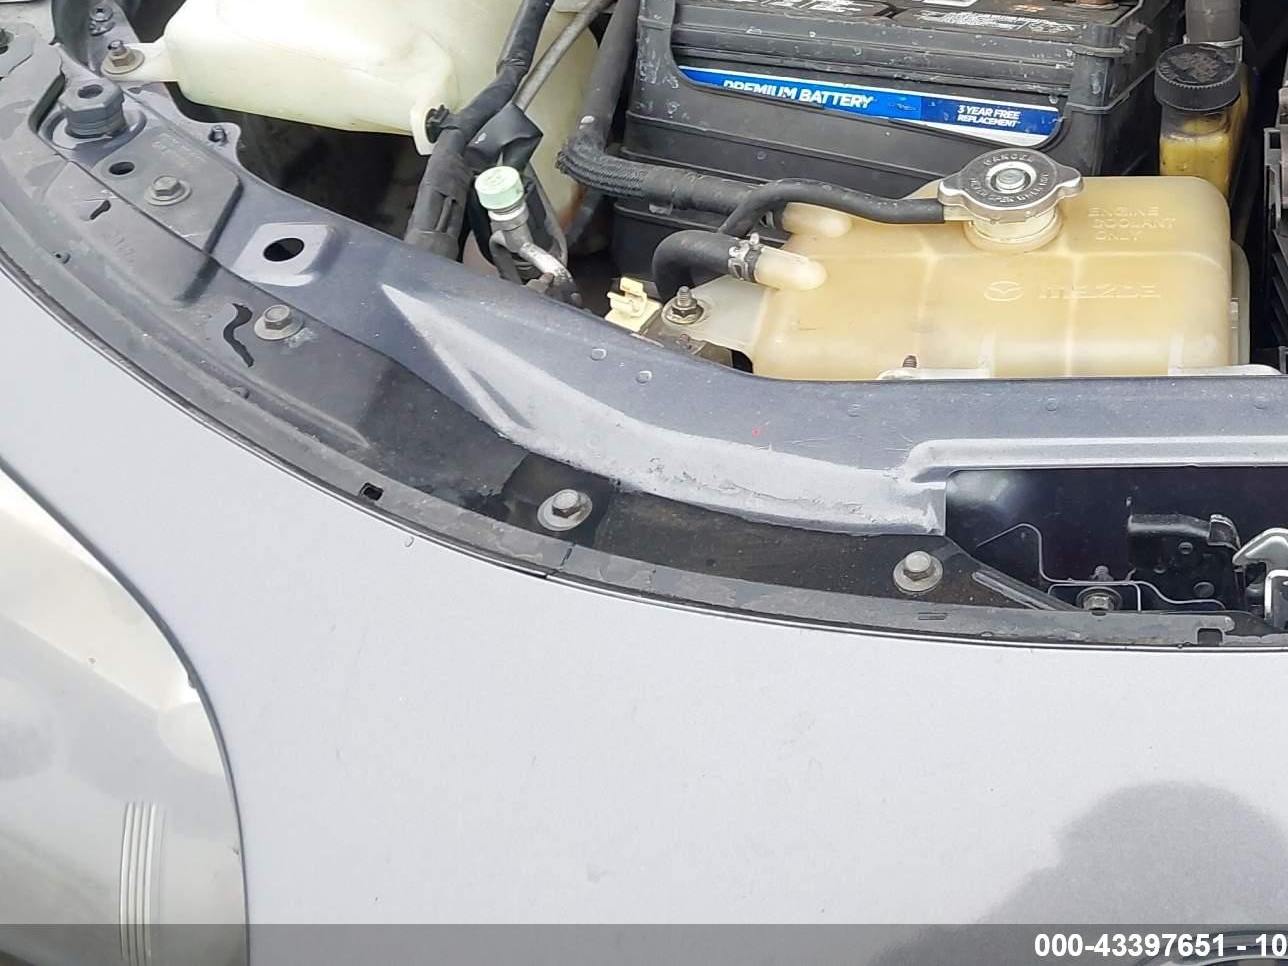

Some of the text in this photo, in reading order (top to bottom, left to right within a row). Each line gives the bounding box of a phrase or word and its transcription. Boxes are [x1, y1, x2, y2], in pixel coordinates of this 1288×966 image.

[799, 88, 874, 109] BATTERY
[957, 105, 1021, 119] 3 YEAR FREE
[1088, 206, 1160, 217] ENGINE
[1093, 218, 1177, 229] COOLANT
[1095, 230, 1143, 242] ONLY
